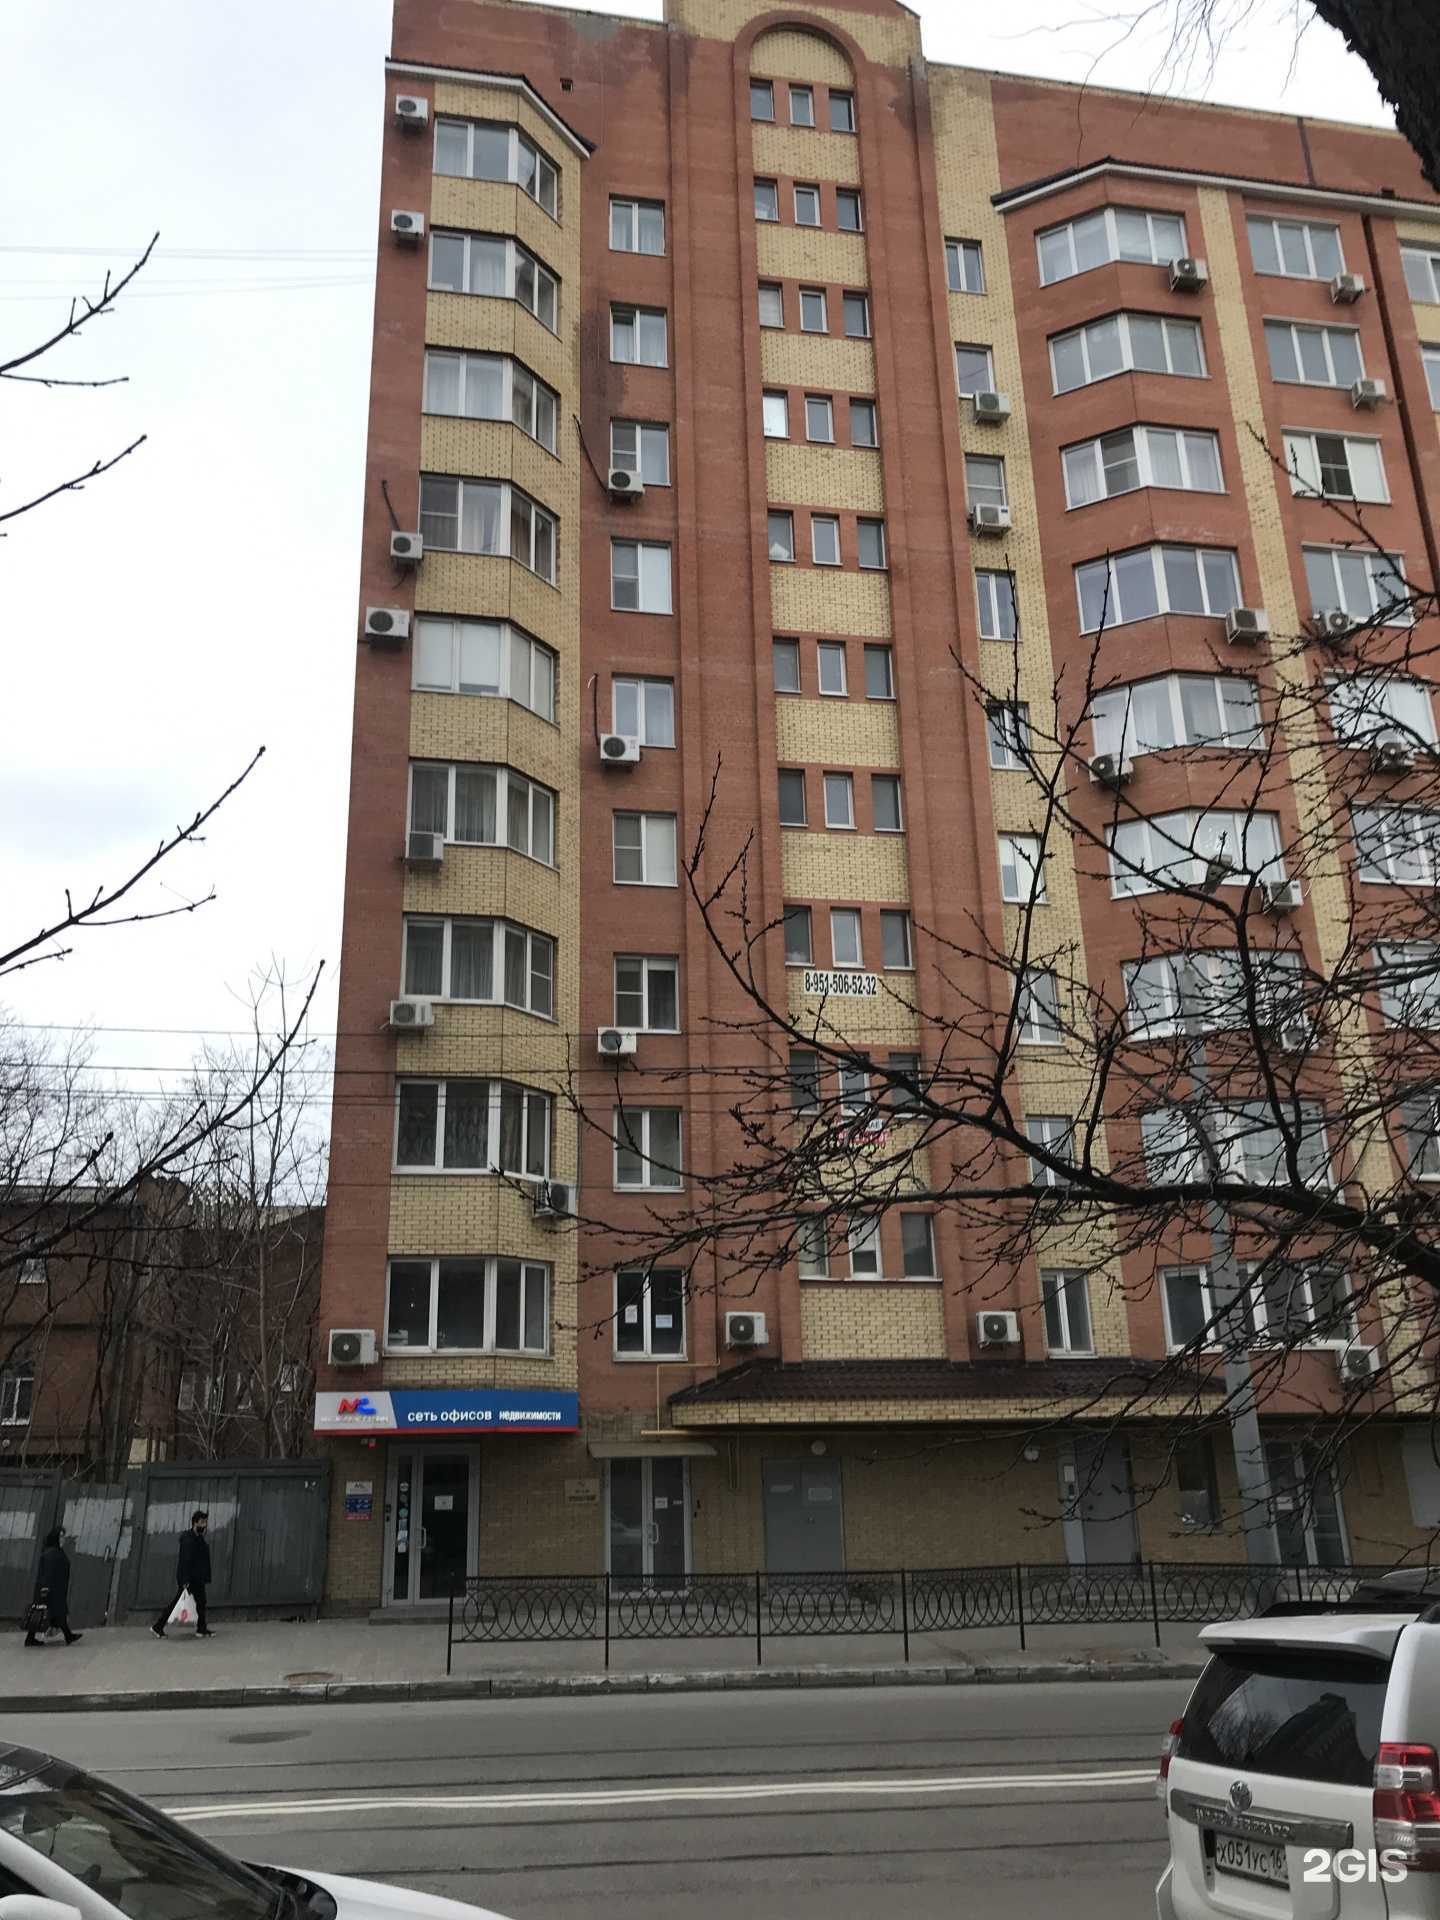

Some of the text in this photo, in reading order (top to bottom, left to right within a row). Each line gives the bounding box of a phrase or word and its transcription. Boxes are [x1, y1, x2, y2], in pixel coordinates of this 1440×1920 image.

[805, 972, 877, 995] 8-951-506-52-32
[408, 1409, 561, 1423] сеть офисов недвижимости
